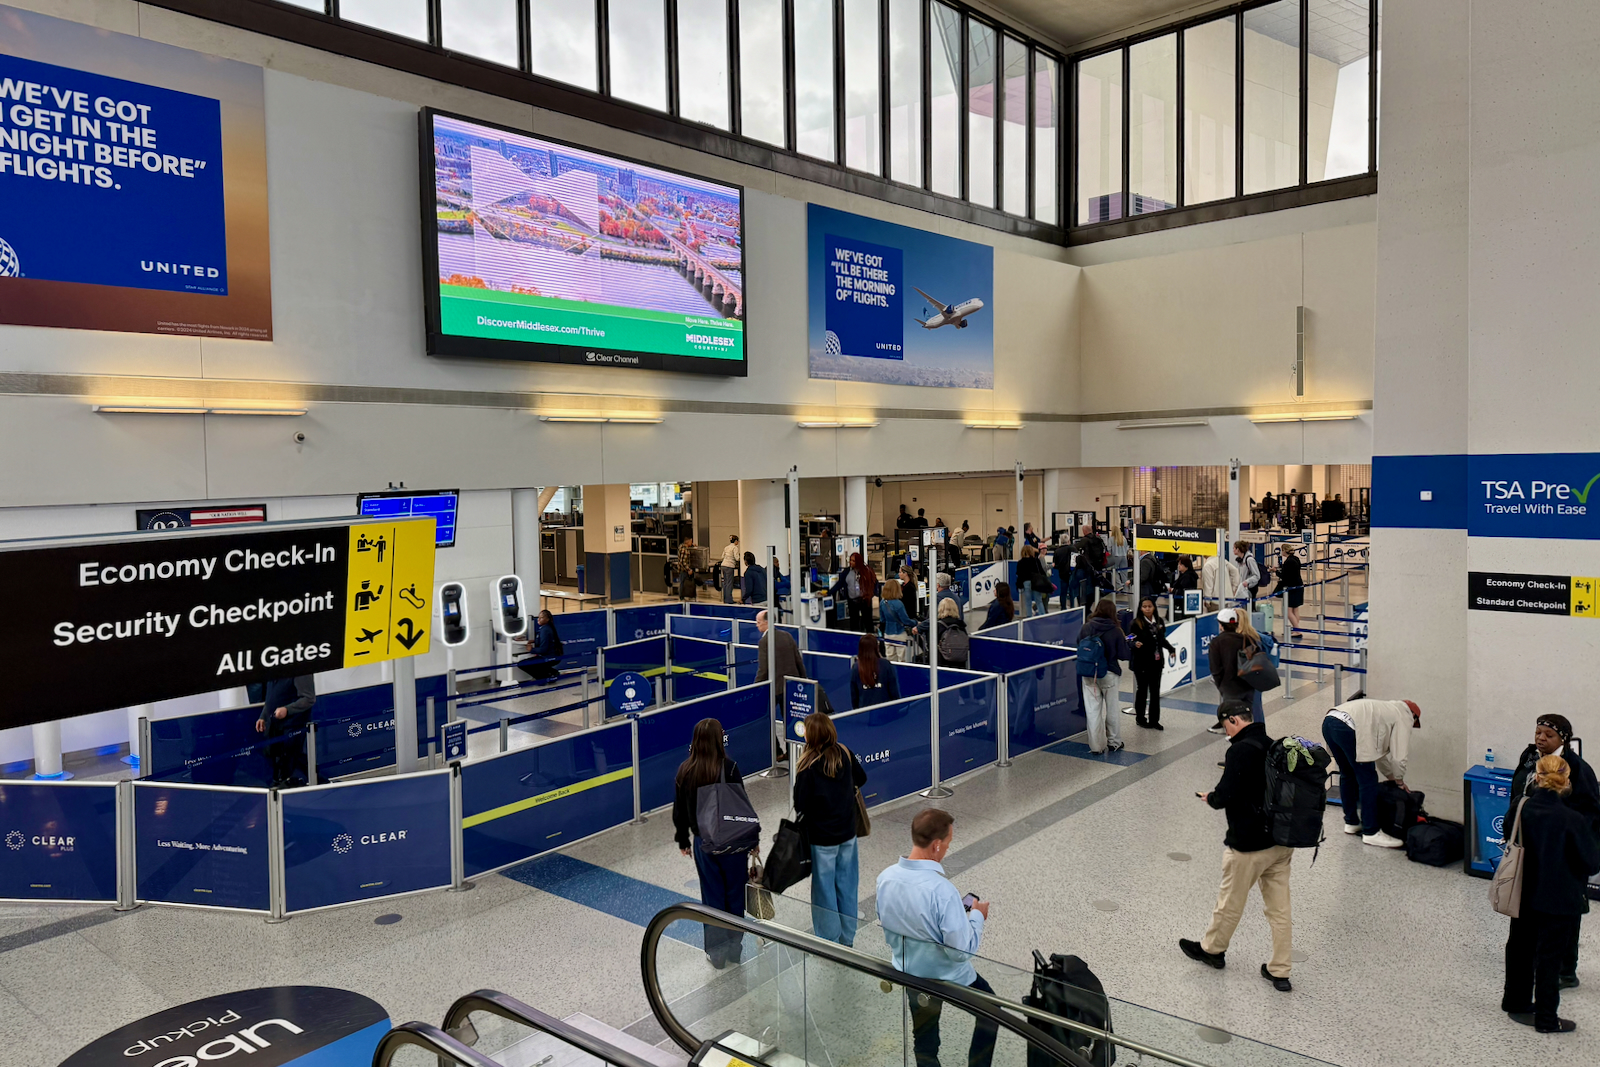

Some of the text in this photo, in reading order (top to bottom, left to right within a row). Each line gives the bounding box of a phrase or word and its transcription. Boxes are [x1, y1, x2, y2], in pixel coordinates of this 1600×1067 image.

[0, 77, 152, 125] WE'VE GOT
[10, 104, 66, 133] GET
[71, 115, 101, 140] IN
[106, 120, 157, 149] THE
[0, 126, 89, 161] NIGHT
[0, 151, 122, 191] FLIGHTS.
[835, 247, 883, 268] WE'VE GOT
[140, 260, 220, 278] UNITED
[850, 264, 862, 277] BE
[862, 266, 888, 282] THERE
[836, 275, 896, 296] THE MORNING
[853, 291, 890, 308] FLIGHTS.
[476, 315, 606, 338] DiscoverMiddlesex.com/Thrive
[685, 316, 697, 324] Move
[685, 333, 735, 347] MIDDLESEX
[875, 342, 901, 351] UNITED
[595, 353, 639, 364] Clear Channel
[1481, 480, 1570, 500] TSA Pre
[1484, 504, 1587, 515] Travel With Ease
[1152, 528, 1199, 539] TSA PreCheck
[851, 538, 860, 548] 19
[79, 543, 336, 587] Economy Check-In
[1486, 578, 1566, 590] Economy Check-In
[1476, 597, 1566, 610] Standard Checkpoint
[53, 590, 335, 648] Security Checkpoint
[216, 642, 332, 677] All Gates
[366, 719, 395, 731] CLEAR
[864, 749, 890, 763] CLEAR
[534, 788, 571, 804] Welcome Back
[31, 836, 75, 846] CLEAR
[360, 829, 406, 845] CLEAR
[157, 839, 248, 855] Less Waiting. More Adventuring
[123, 1009, 242, 1057] Pickup
